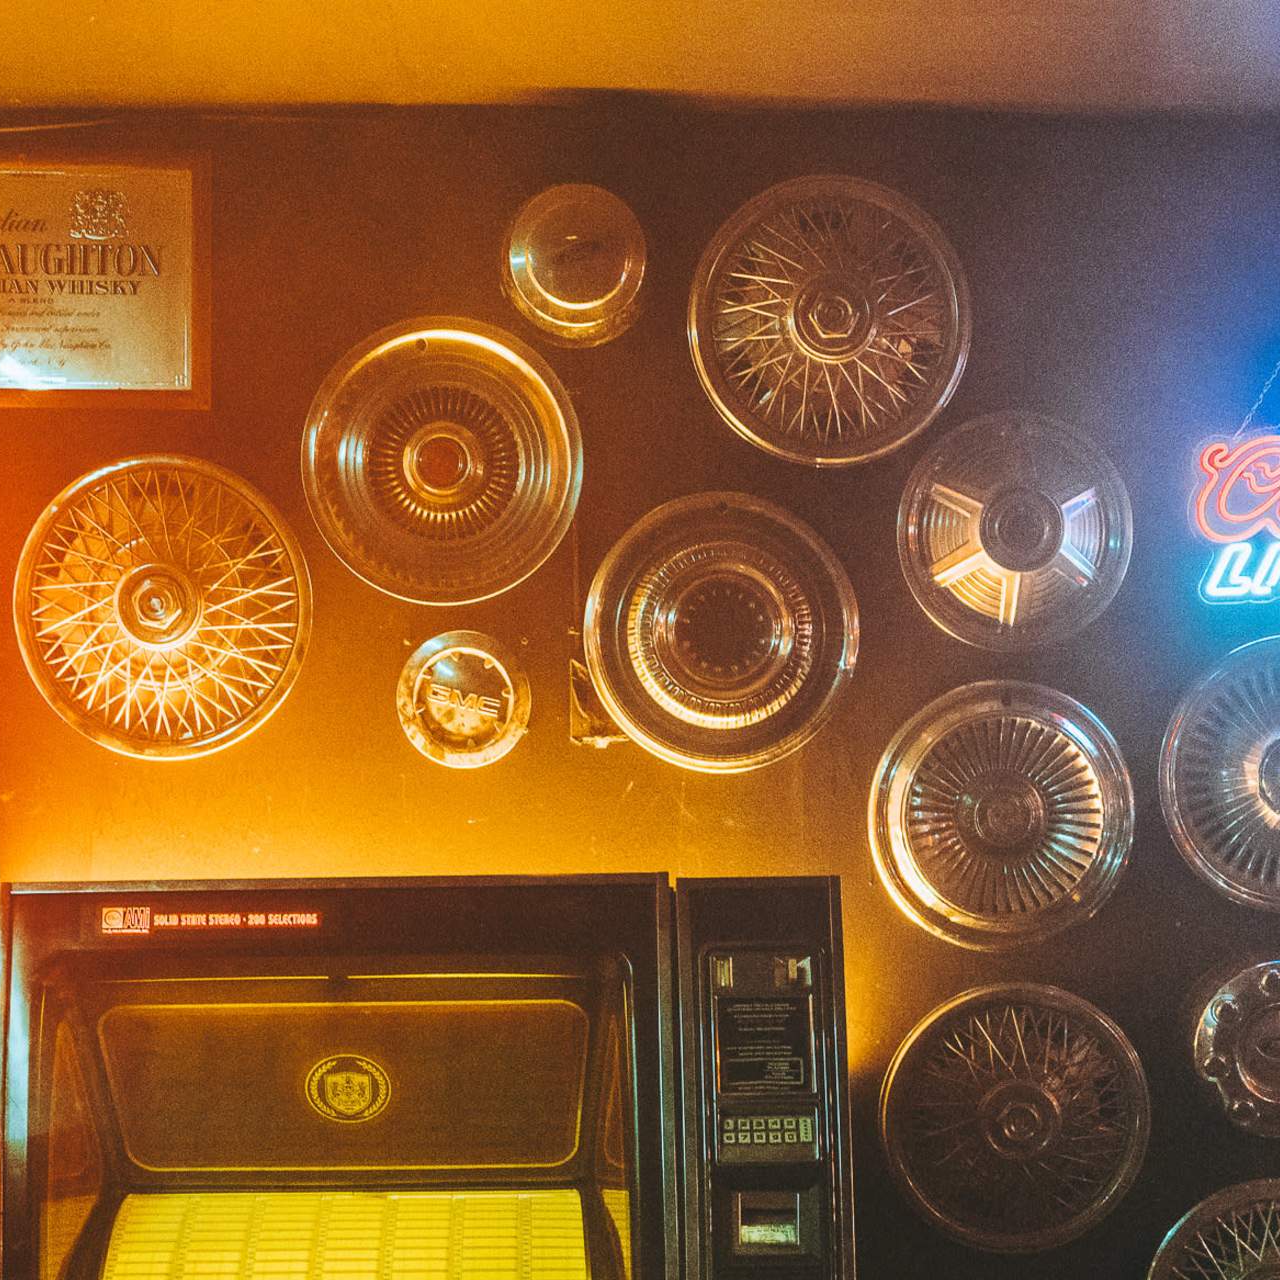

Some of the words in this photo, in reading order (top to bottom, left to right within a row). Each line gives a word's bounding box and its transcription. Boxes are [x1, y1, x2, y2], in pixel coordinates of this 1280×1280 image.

[47, 278, 143, 296] WHISKY
[427, 683, 501, 718] GMC
[154, 914, 179, 926] SOLID
[181, 914, 207, 926] STATE
[209, 914, 241, 926] STEREO
[268, 913, 318, 926] SELECTIONS
